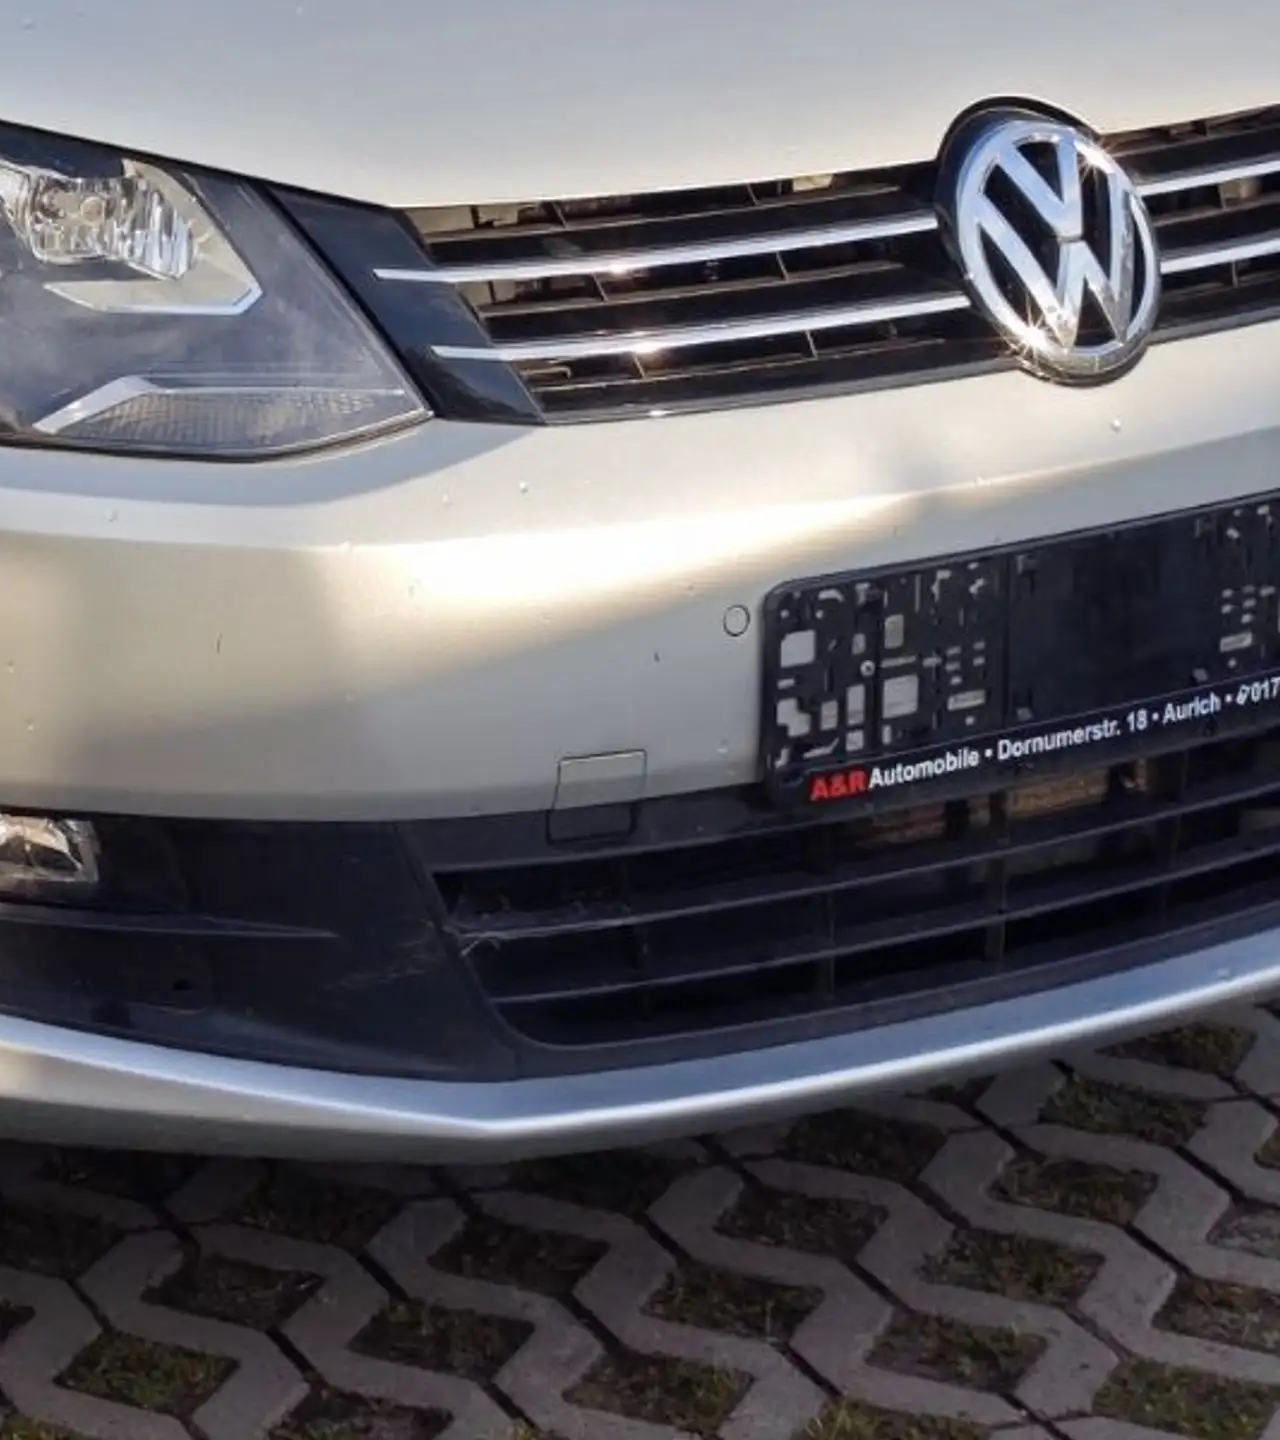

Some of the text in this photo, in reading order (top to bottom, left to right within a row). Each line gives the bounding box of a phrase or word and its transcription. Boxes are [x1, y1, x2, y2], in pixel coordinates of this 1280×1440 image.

[810, 770, 867, 801] A&R
[868, 749, 980, 789] Automobile
[997, 718, 1122, 760] Dornumerstr.
[1127, 709, 1149, 733] 18
[1163, 691, 1221, 725] Aurich
